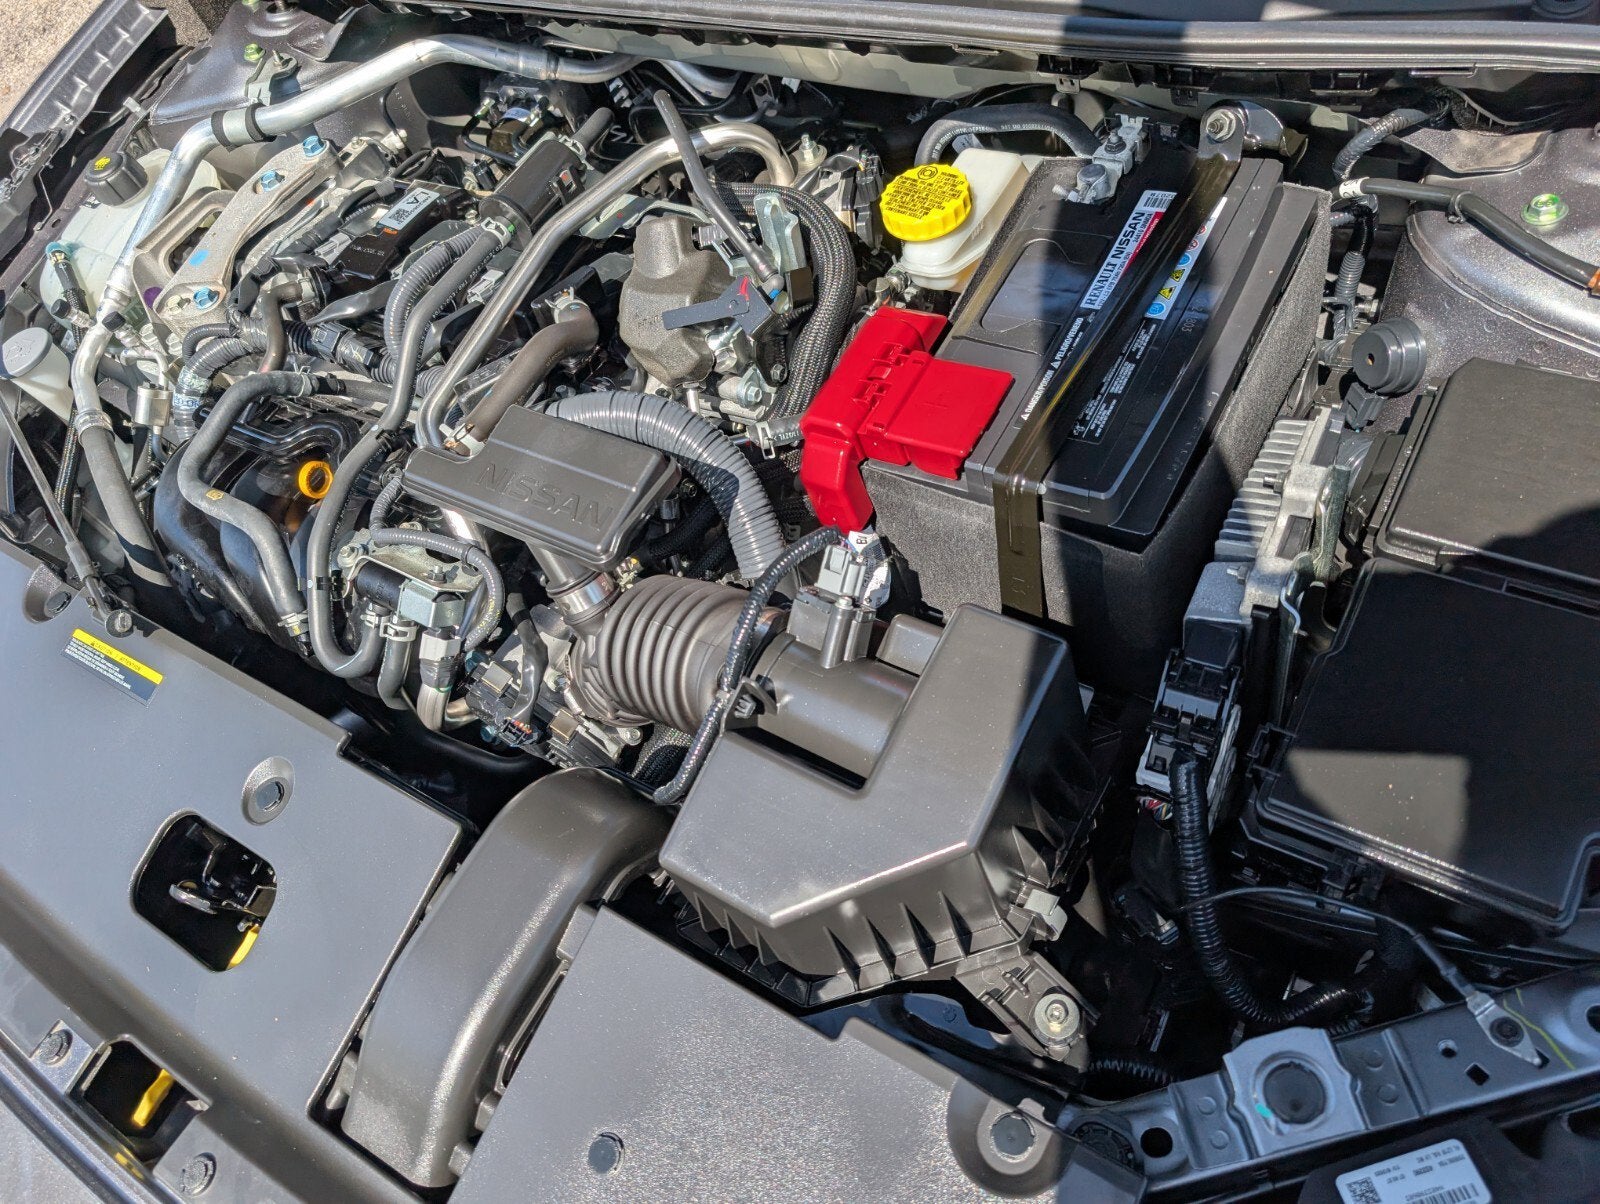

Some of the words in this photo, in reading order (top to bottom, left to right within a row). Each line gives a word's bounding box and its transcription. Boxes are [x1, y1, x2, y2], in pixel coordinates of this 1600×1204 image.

[1085, 262, 1117, 306] RENAULT
[1111, 212, 1146, 259] NISSAN
[475, 463, 613, 531] NISSAN
